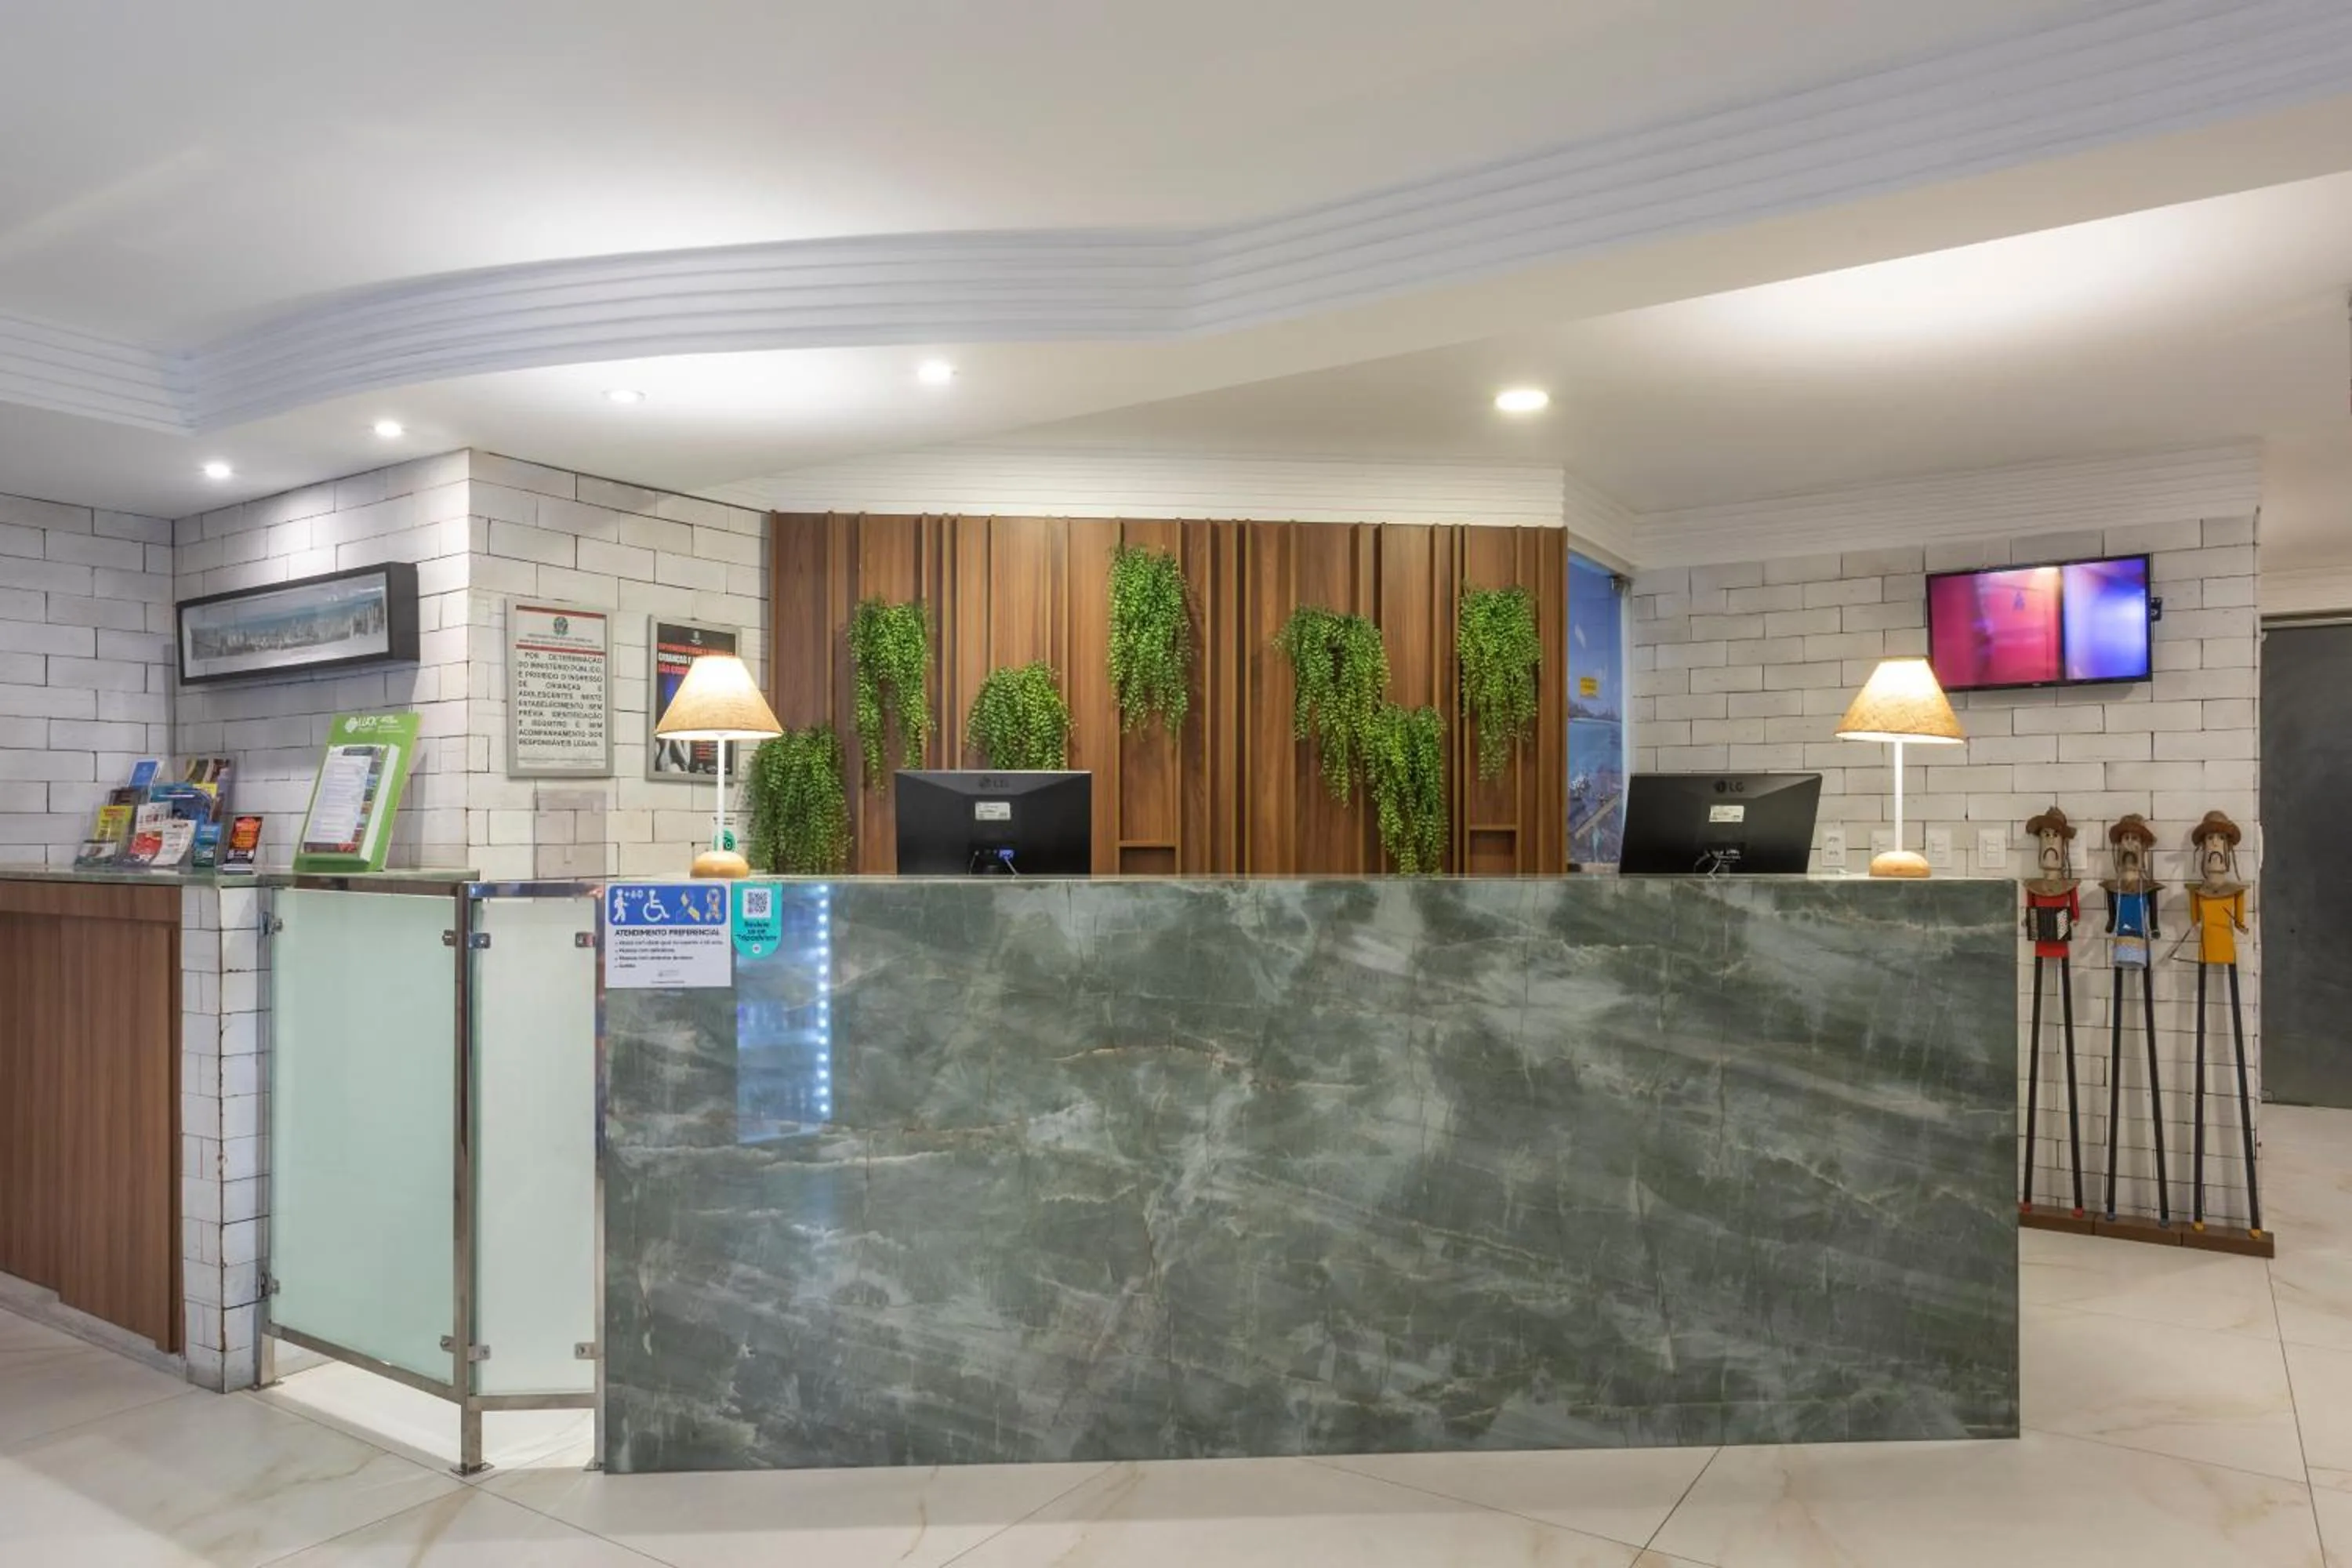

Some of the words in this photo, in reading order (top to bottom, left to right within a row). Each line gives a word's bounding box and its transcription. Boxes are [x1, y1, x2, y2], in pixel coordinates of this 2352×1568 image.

[1729, 781, 1745, 793] LG
[615, 928, 666, 937] ATENDIMENTO
[669, 927, 720, 937] PREFERENCIAL
